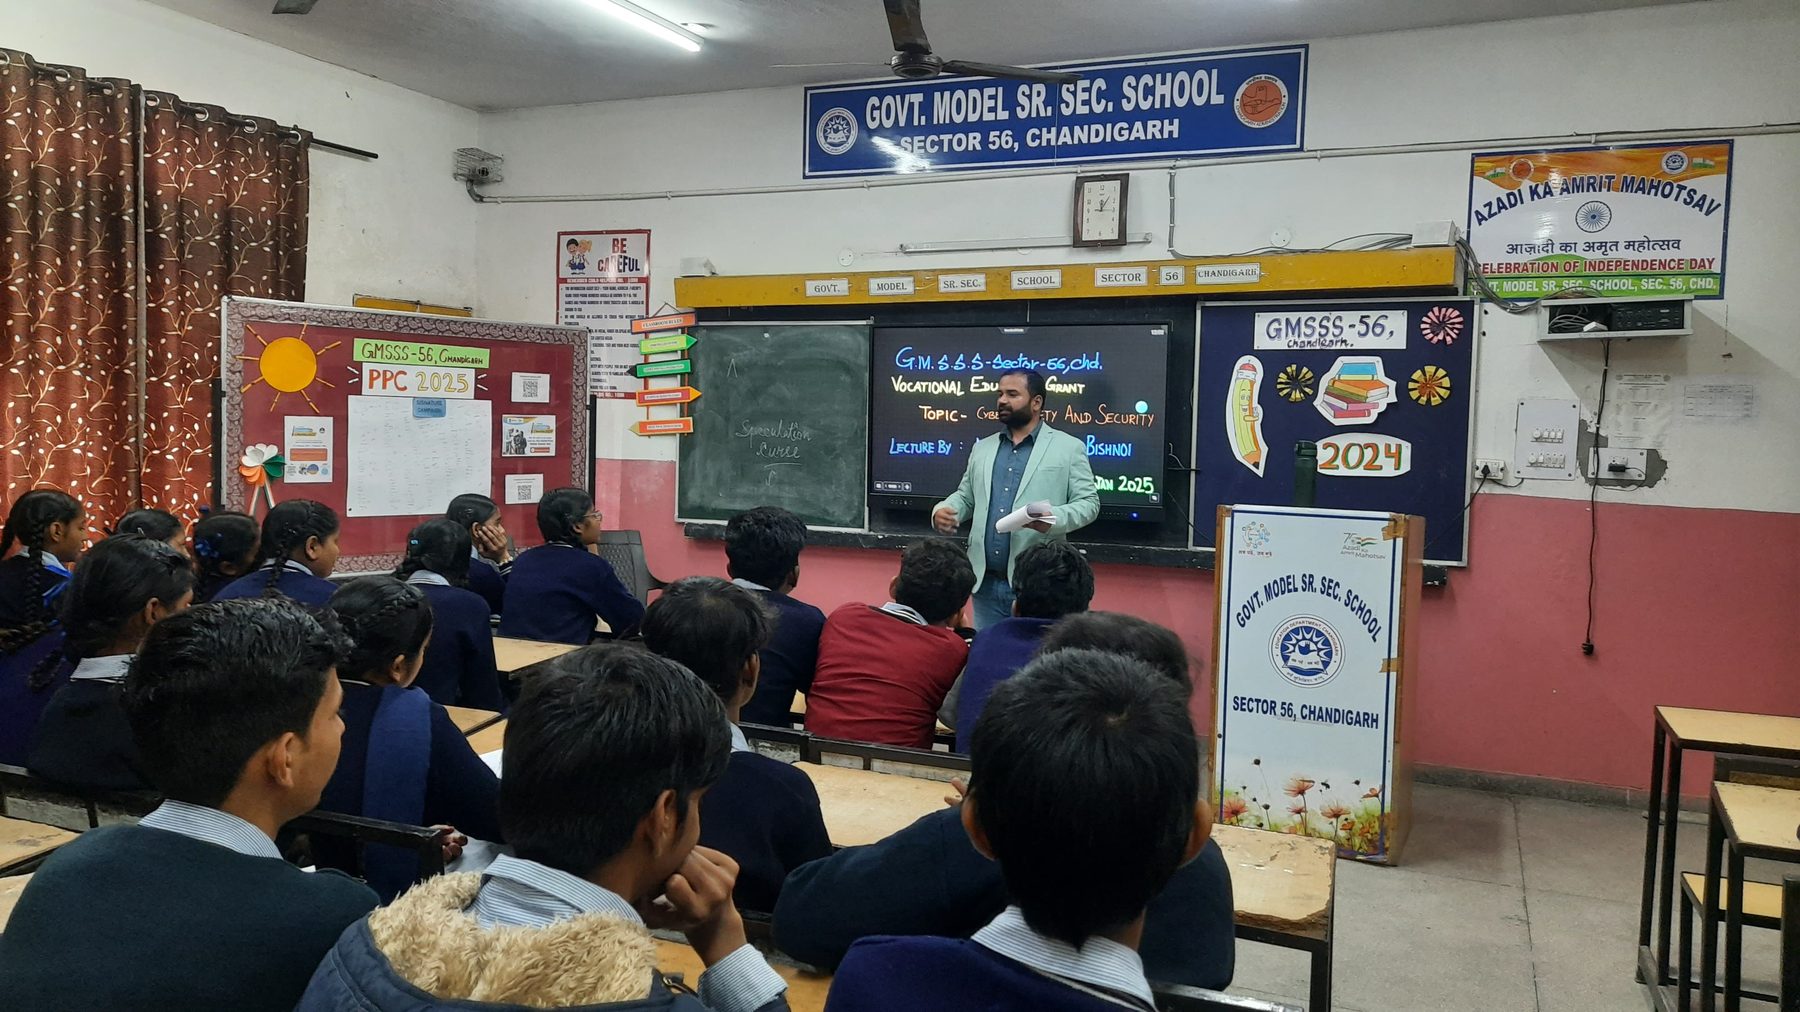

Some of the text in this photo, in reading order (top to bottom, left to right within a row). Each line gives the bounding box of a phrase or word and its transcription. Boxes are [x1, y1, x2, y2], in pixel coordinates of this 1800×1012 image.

[866, 69, 1224, 130] GOVT. MODEL SR. SEC. SCHOOL
[900, 119, 1179, 154] SECTOR 56, CHANDIGARH
[1474, 175, 1722, 227] AZADI KA AMRIT MAHOTSAV
[612, 238, 627, 253] BE
[1559, 241, 1577, 253] का
[1582, 241, 1619, 256] अमृत
[1624, 235, 1681, 253] महोत्सव
[1480, 258, 1715, 274] ELEBRATION OF INDEPENDENCE DAY
[814, 268, 1257, 293] GOVT. MODEL SR. SEC. SCHOOL SECTOR 56 CHANDIGARH
[1503, 281, 1539, 292] MODEL
[1542, 280, 1559, 291] SR.
[1590, 279, 1637, 292] SCHOOL,
[1641, 278, 1666, 290] SEC.
[1670, 277, 1686, 291] 56,
[1689, 277, 1717, 289] CHD.
[368, 369, 469, 393] PPC 2025
[891, 375, 964, 397] VOCATIONAL
[1045, 375, 1085, 394] GRANT
[1064, 404, 1092, 424] AND
[1095, 403, 1154, 427] SECURITY
[889, 438, 934, 454] LECTURE
[1087, 435, 1132, 456] BISHNOI
[1319, 442, 1402, 471] 2024
[1094, 475, 1154, 494] JAN 2025
[1236, 573, 1382, 643] GOVT. MODEL SR. SEC. SCHOOL
[1233, 695, 1379, 729] SECTOR 56, CHANDIGARH
